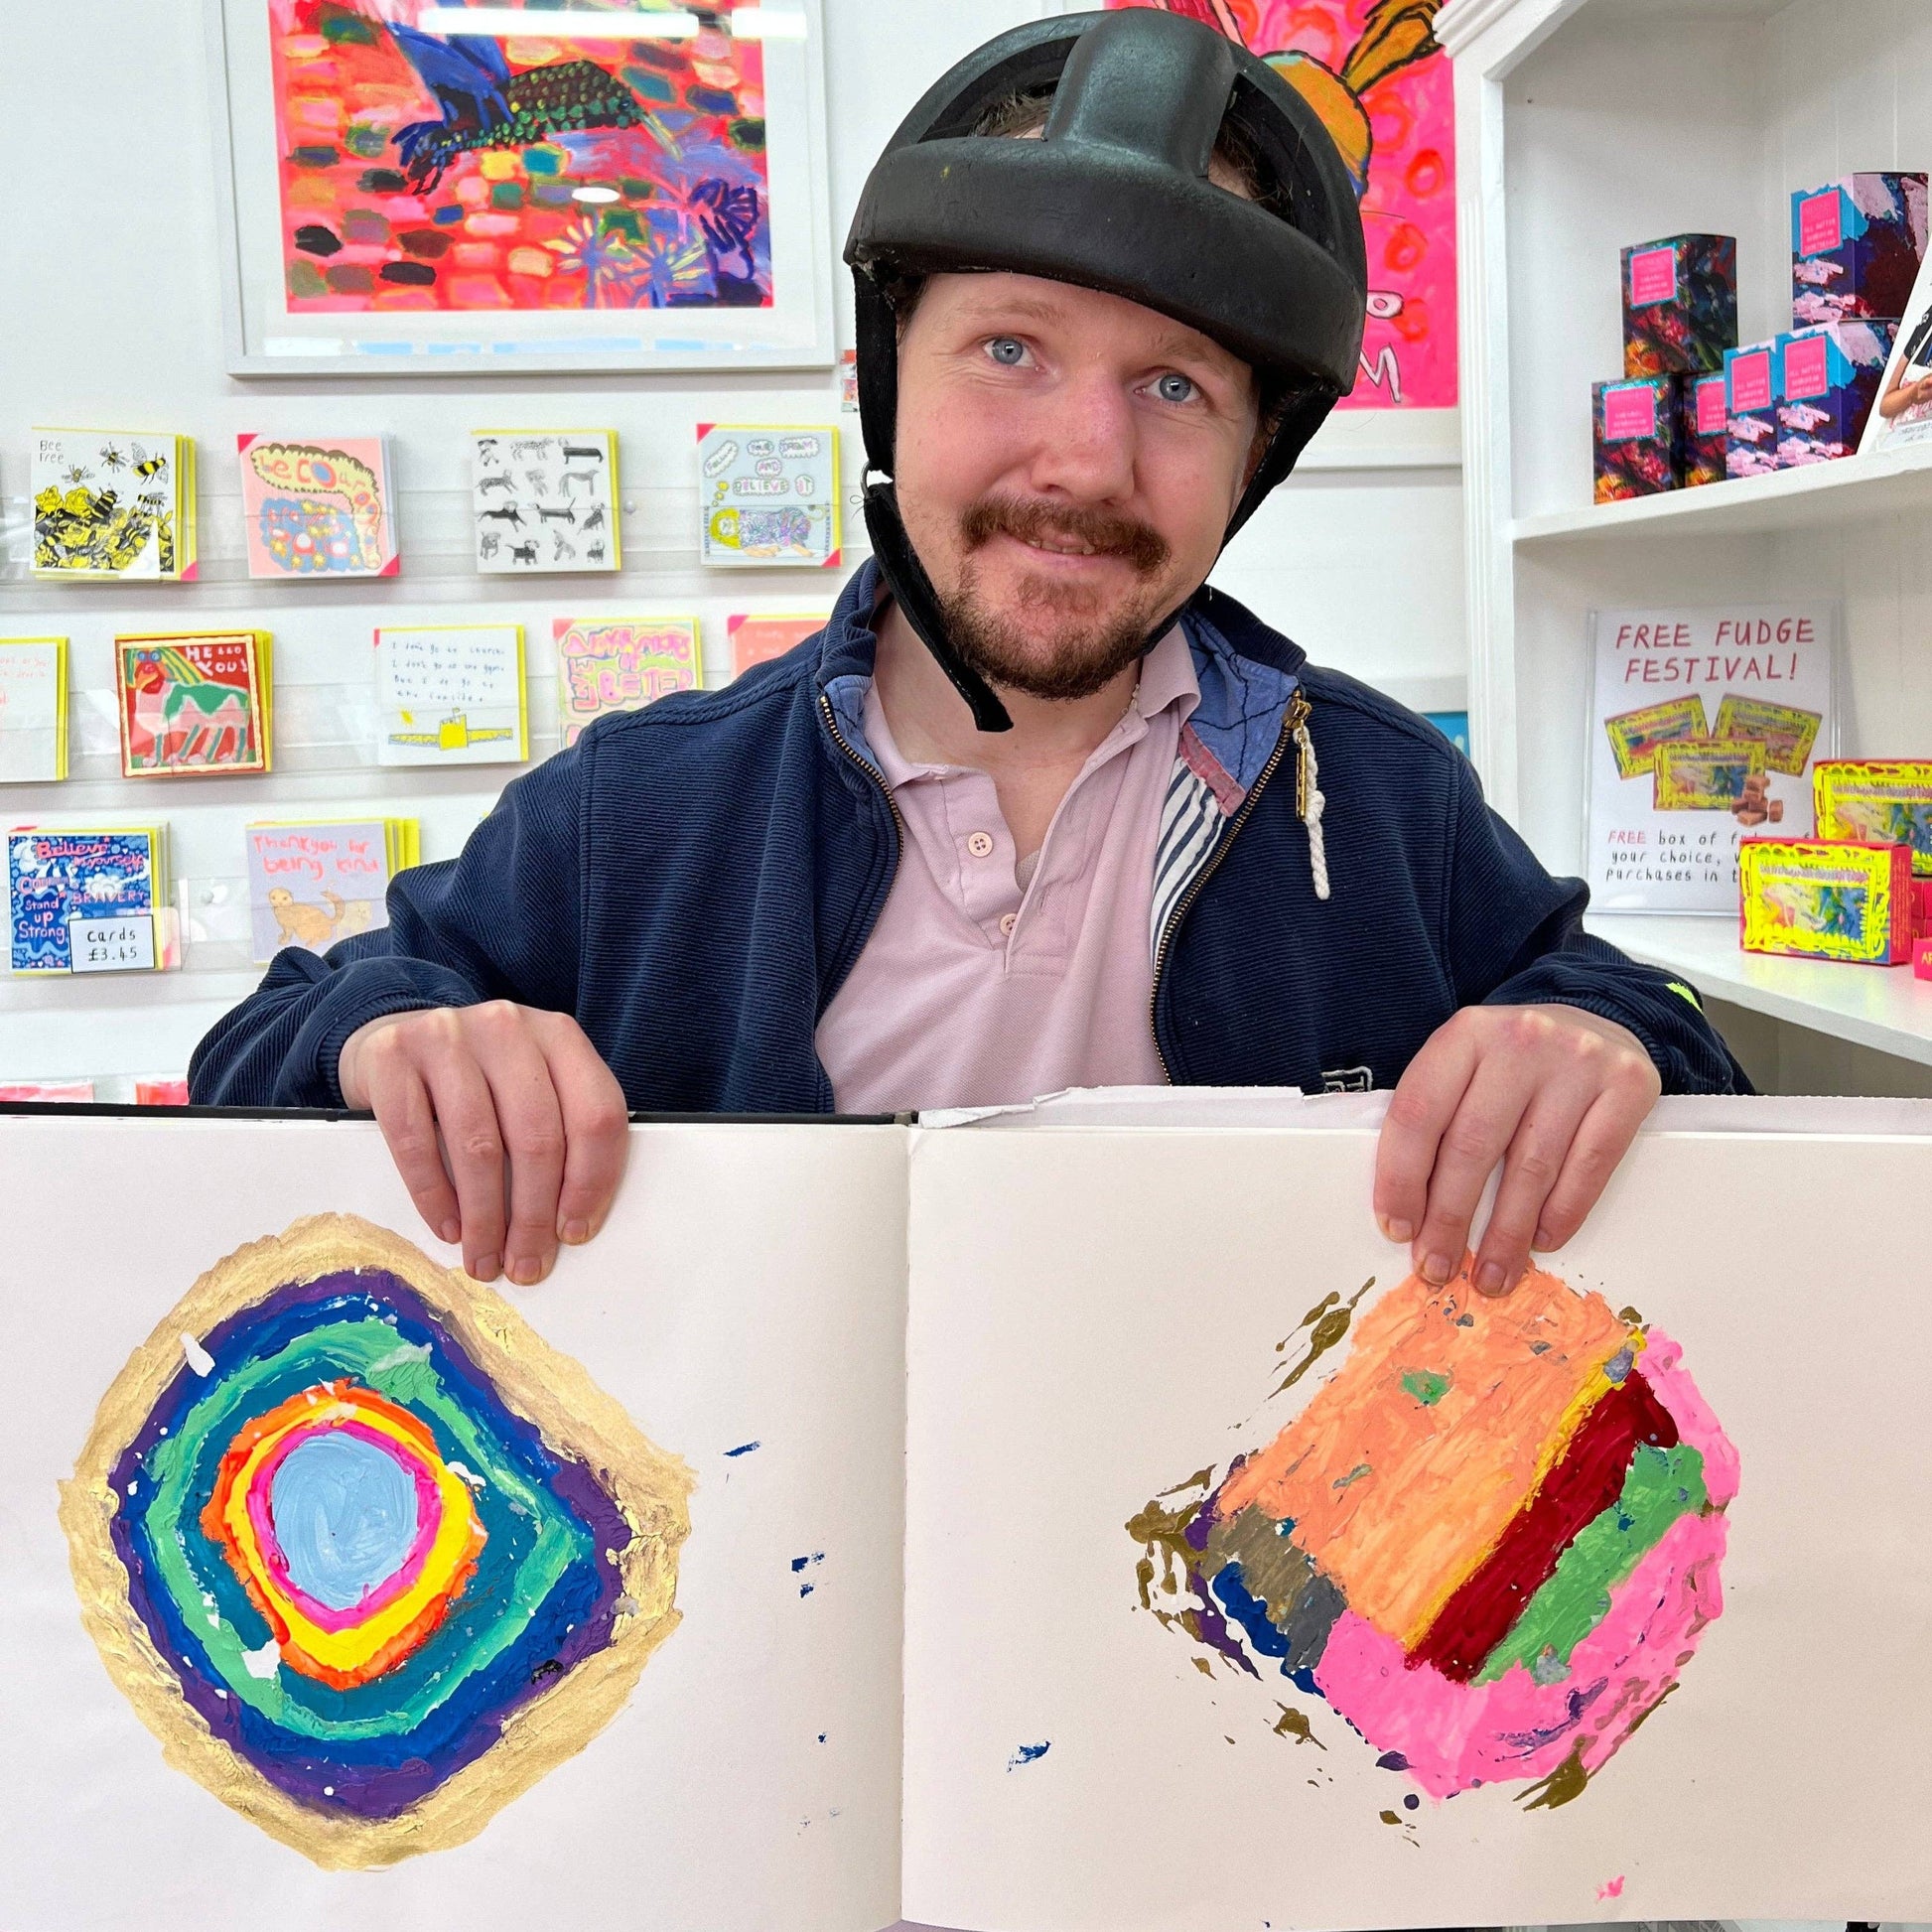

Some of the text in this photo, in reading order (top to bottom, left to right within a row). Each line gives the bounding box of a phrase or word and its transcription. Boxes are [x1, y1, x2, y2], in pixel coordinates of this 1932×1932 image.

[40, 440, 63, 452] Bee
[40, 452, 65, 465] Free
[734, 480, 789, 493] BELIEVE
[1615, 617, 1815, 649] FREE FUDGE
[430, 643, 440, 655] go
[195, 658, 248, 677] YOU!
[1624, 651, 1798, 684] FESTIVAL!
[1607, 830, 1648, 845] FREE
[1658, 829, 1687, 845] box
[1698, 830, 1718, 845] of
[36, 840, 109, 860] Believe
[1611, 851, 1648, 865] your
[1659, 850, 1723, 866] choice,
[262, 856, 379, 882] being kind
[1605, 866, 1693, 884] purchases
[1704, 868, 1719, 883] in
[26, 897, 60, 911] Stand
[71, 890, 146, 904] BRAVERY
[34, 910, 55, 927] up
[18, 920, 67, 945] Strong
[87, 946, 138, 962] £3.45
